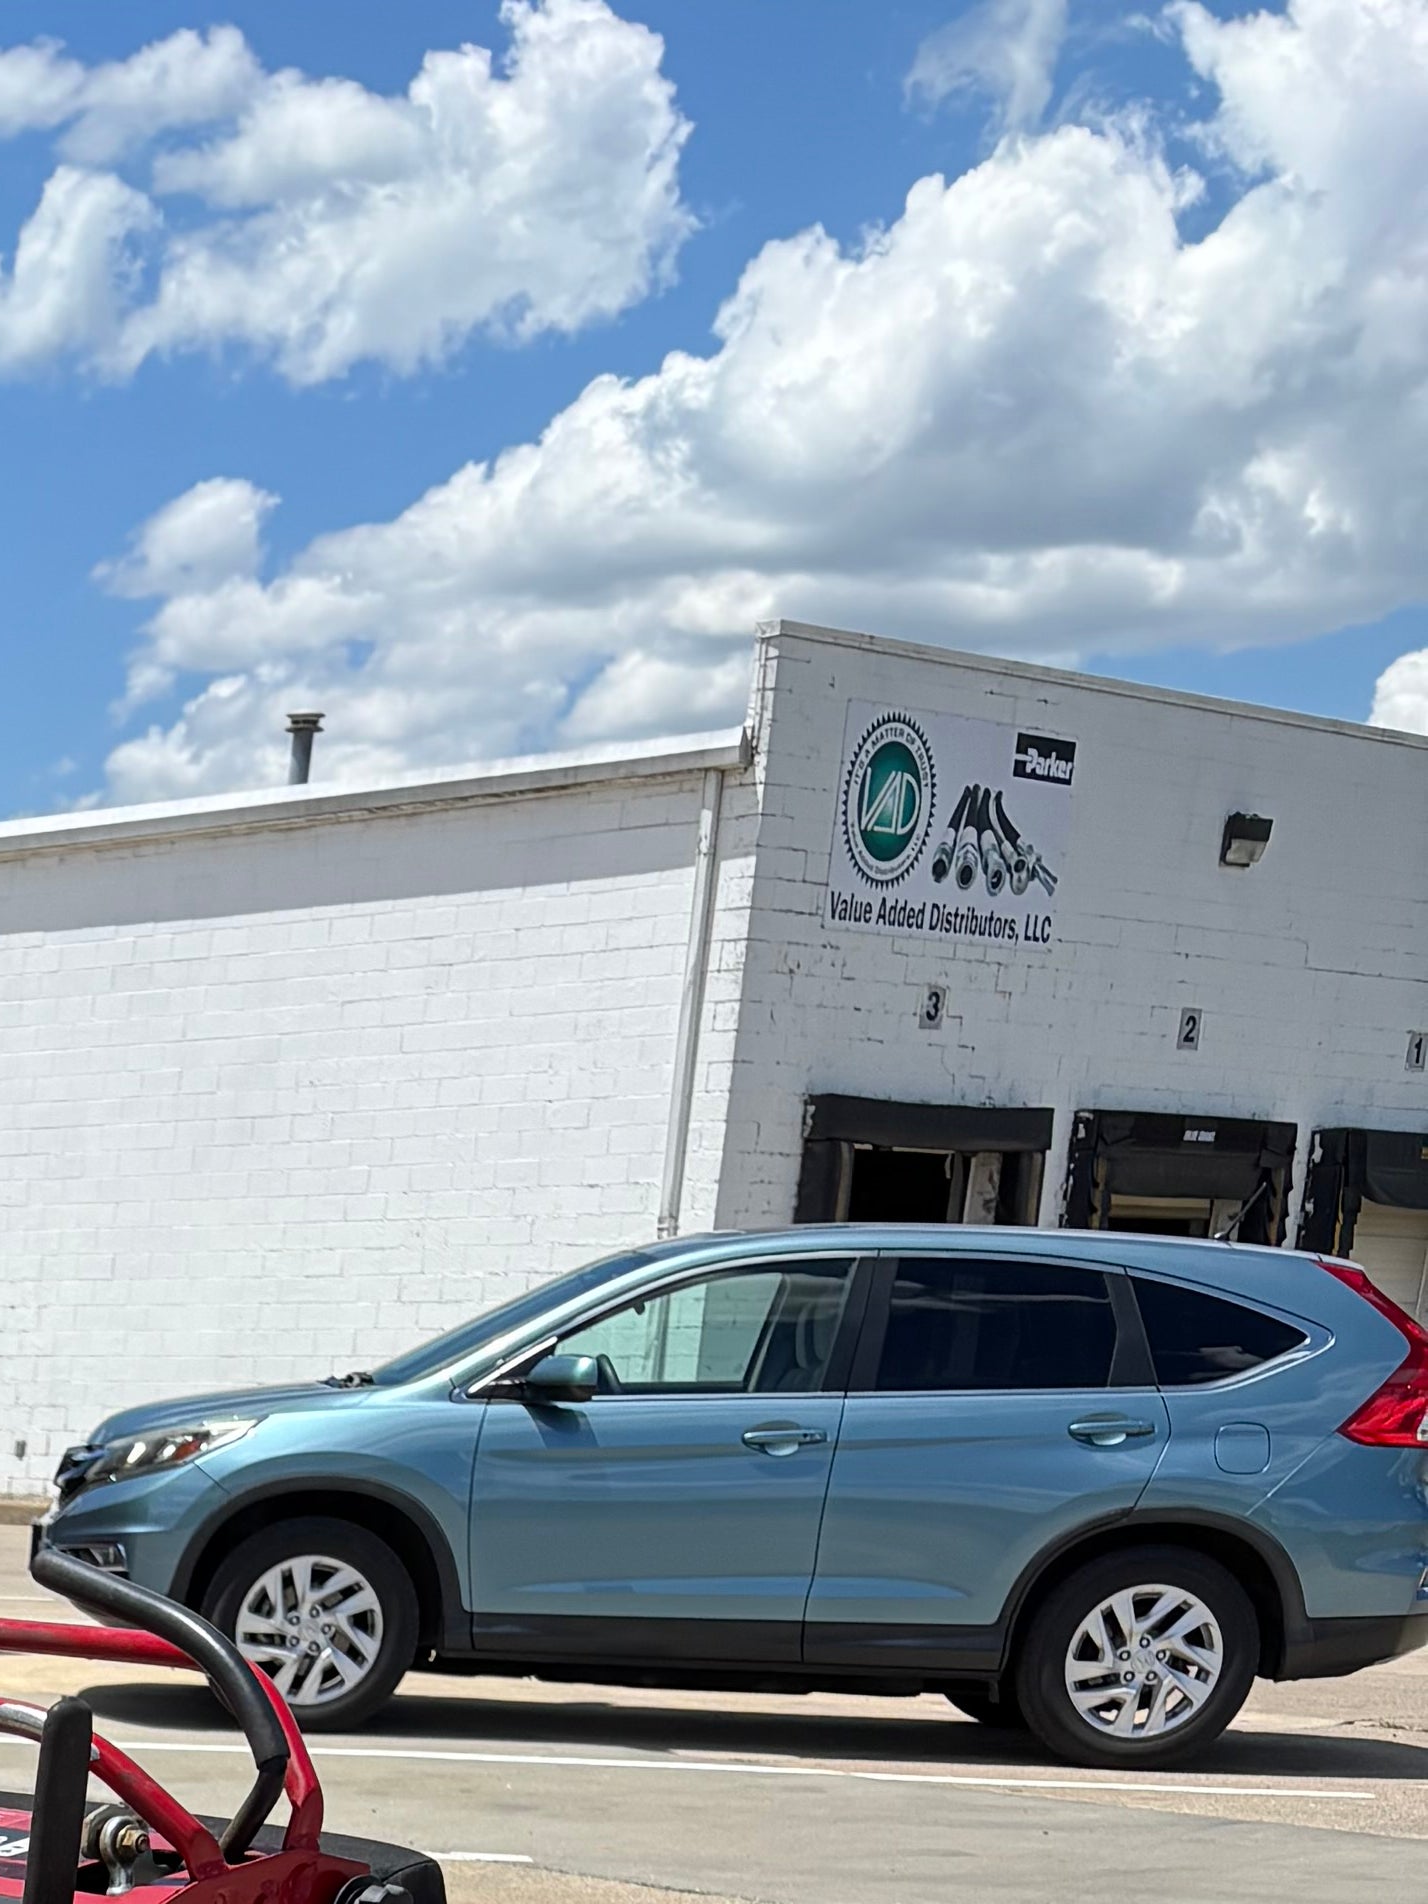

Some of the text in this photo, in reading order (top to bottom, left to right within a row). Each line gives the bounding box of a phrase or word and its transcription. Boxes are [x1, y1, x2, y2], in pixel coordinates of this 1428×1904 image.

[1025, 747, 1073, 780] Parker
[830, 891, 1052, 946] Value Added Distributors, LLC
[925, 991, 941, 1022] 3
[1182, 1015, 1197, 1043] 2
[1414, 1037, 1423, 1064] 1
